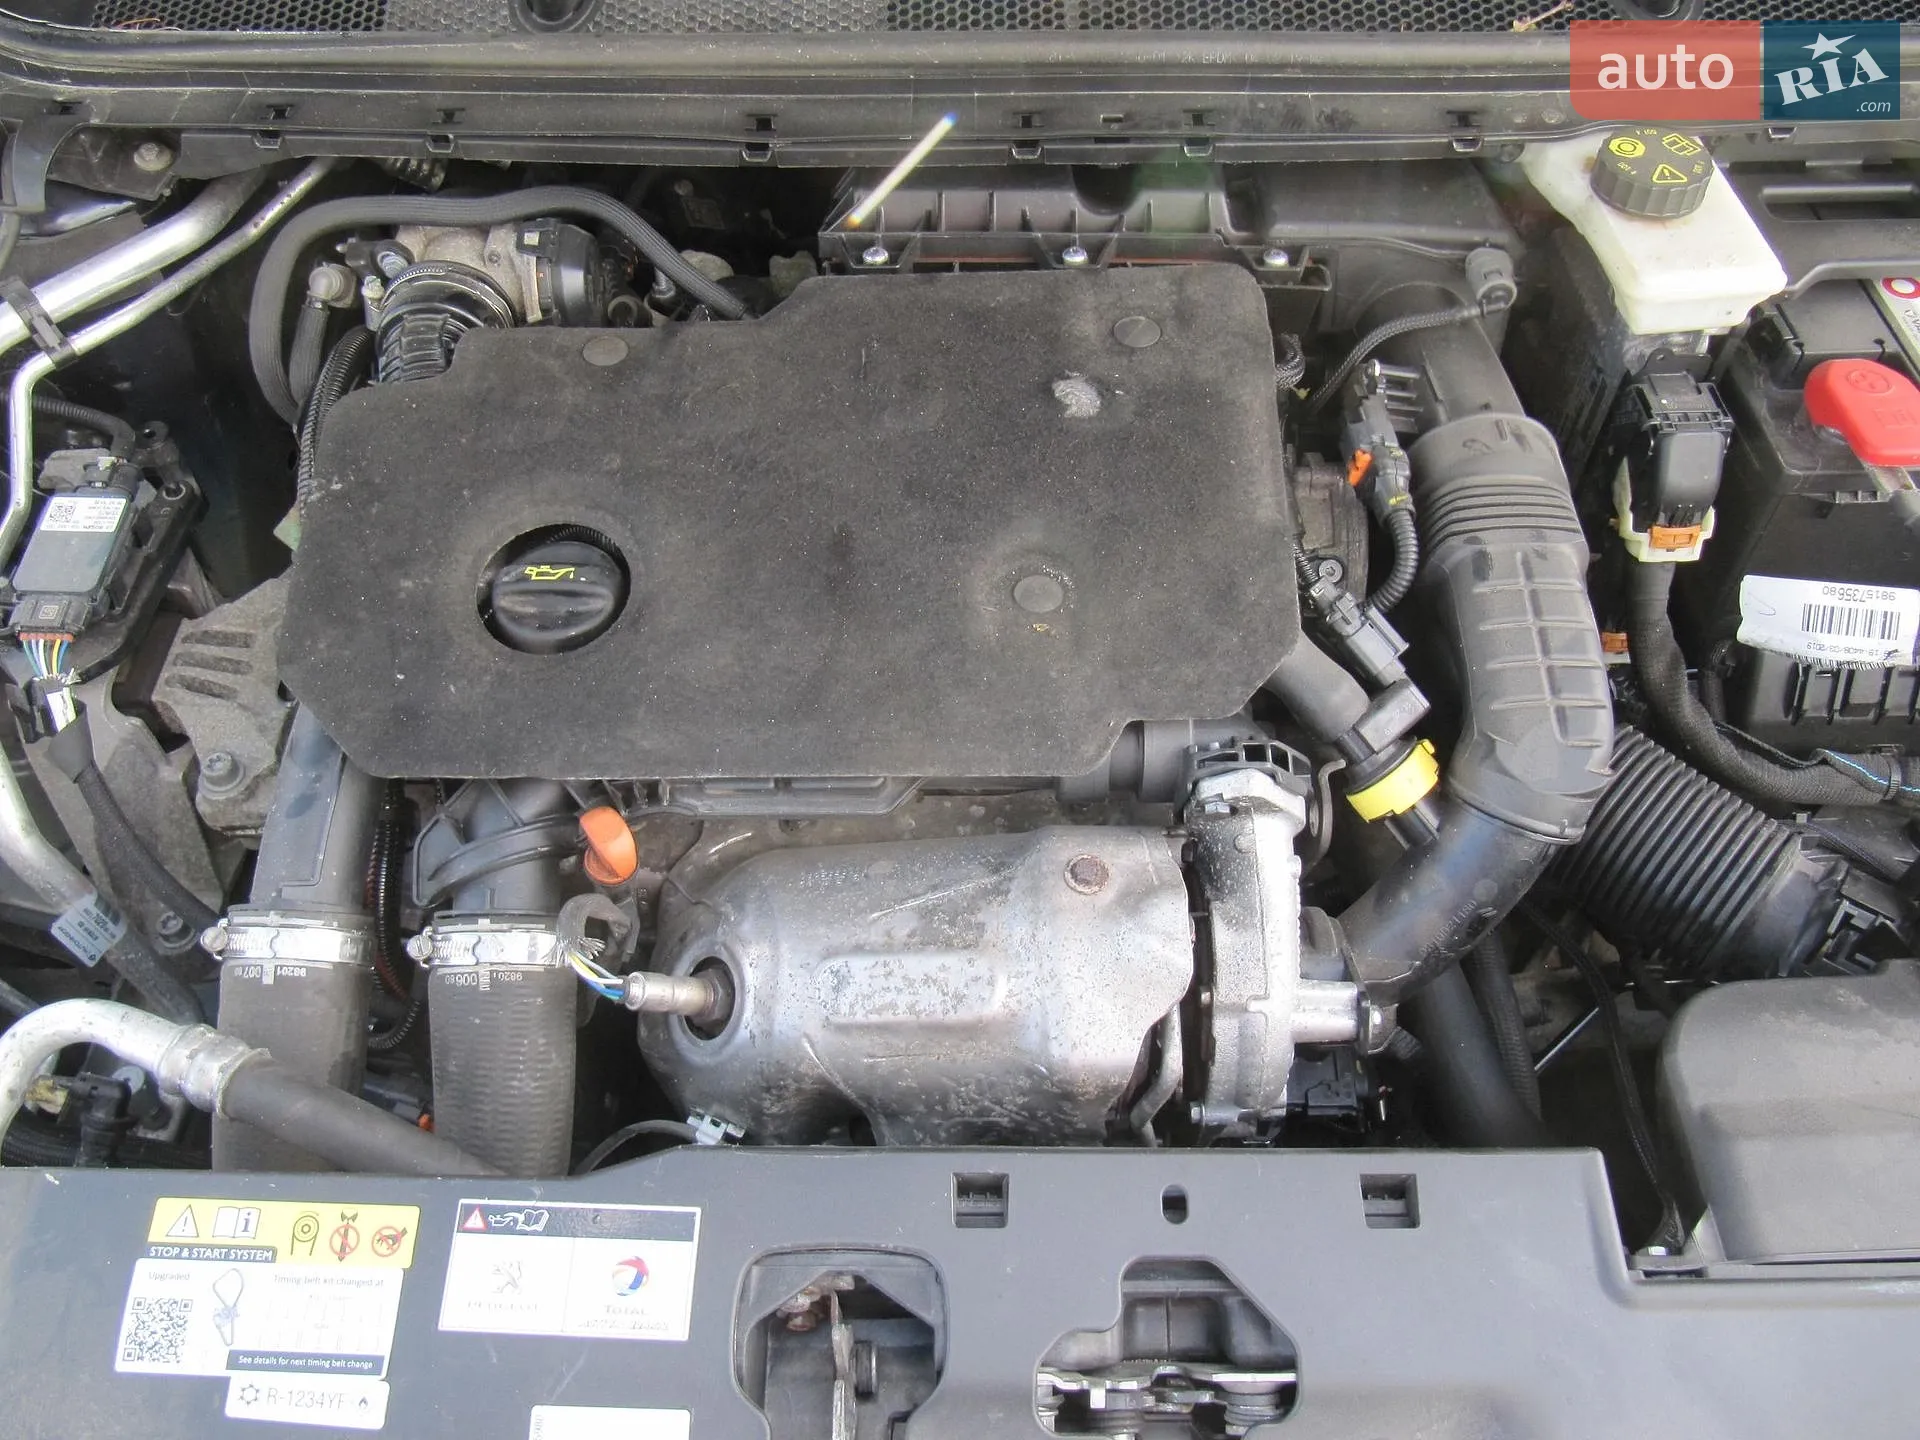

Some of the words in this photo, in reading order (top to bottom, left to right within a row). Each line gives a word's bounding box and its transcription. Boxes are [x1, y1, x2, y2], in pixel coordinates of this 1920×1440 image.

[1822, 585, 1897, 602] 9815735680
[149, 1246, 179, 1259] STOP
[181, 1247, 190, 1259] &
[191, 1248, 228, 1260] START
[229, 1248, 274, 1262] SYSTEM
[148, 1271, 191, 1282] Upgraded
[274, 1274, 301, 1286] Timing
[336, 1277, 374, 1290] changed
[238, 1355, 252, 1364] See
[254, 1355, 277, 1365] details
[278, 1356, 289, 1366] for
[290, 1358, 306, 1366] next
[307, 1358, 330, 1369] timing
[332, 1358, 346, 1368] belt
[347, 1360, 373, 1370] change
[266, 1387, 345, 1410] R-1234YF
